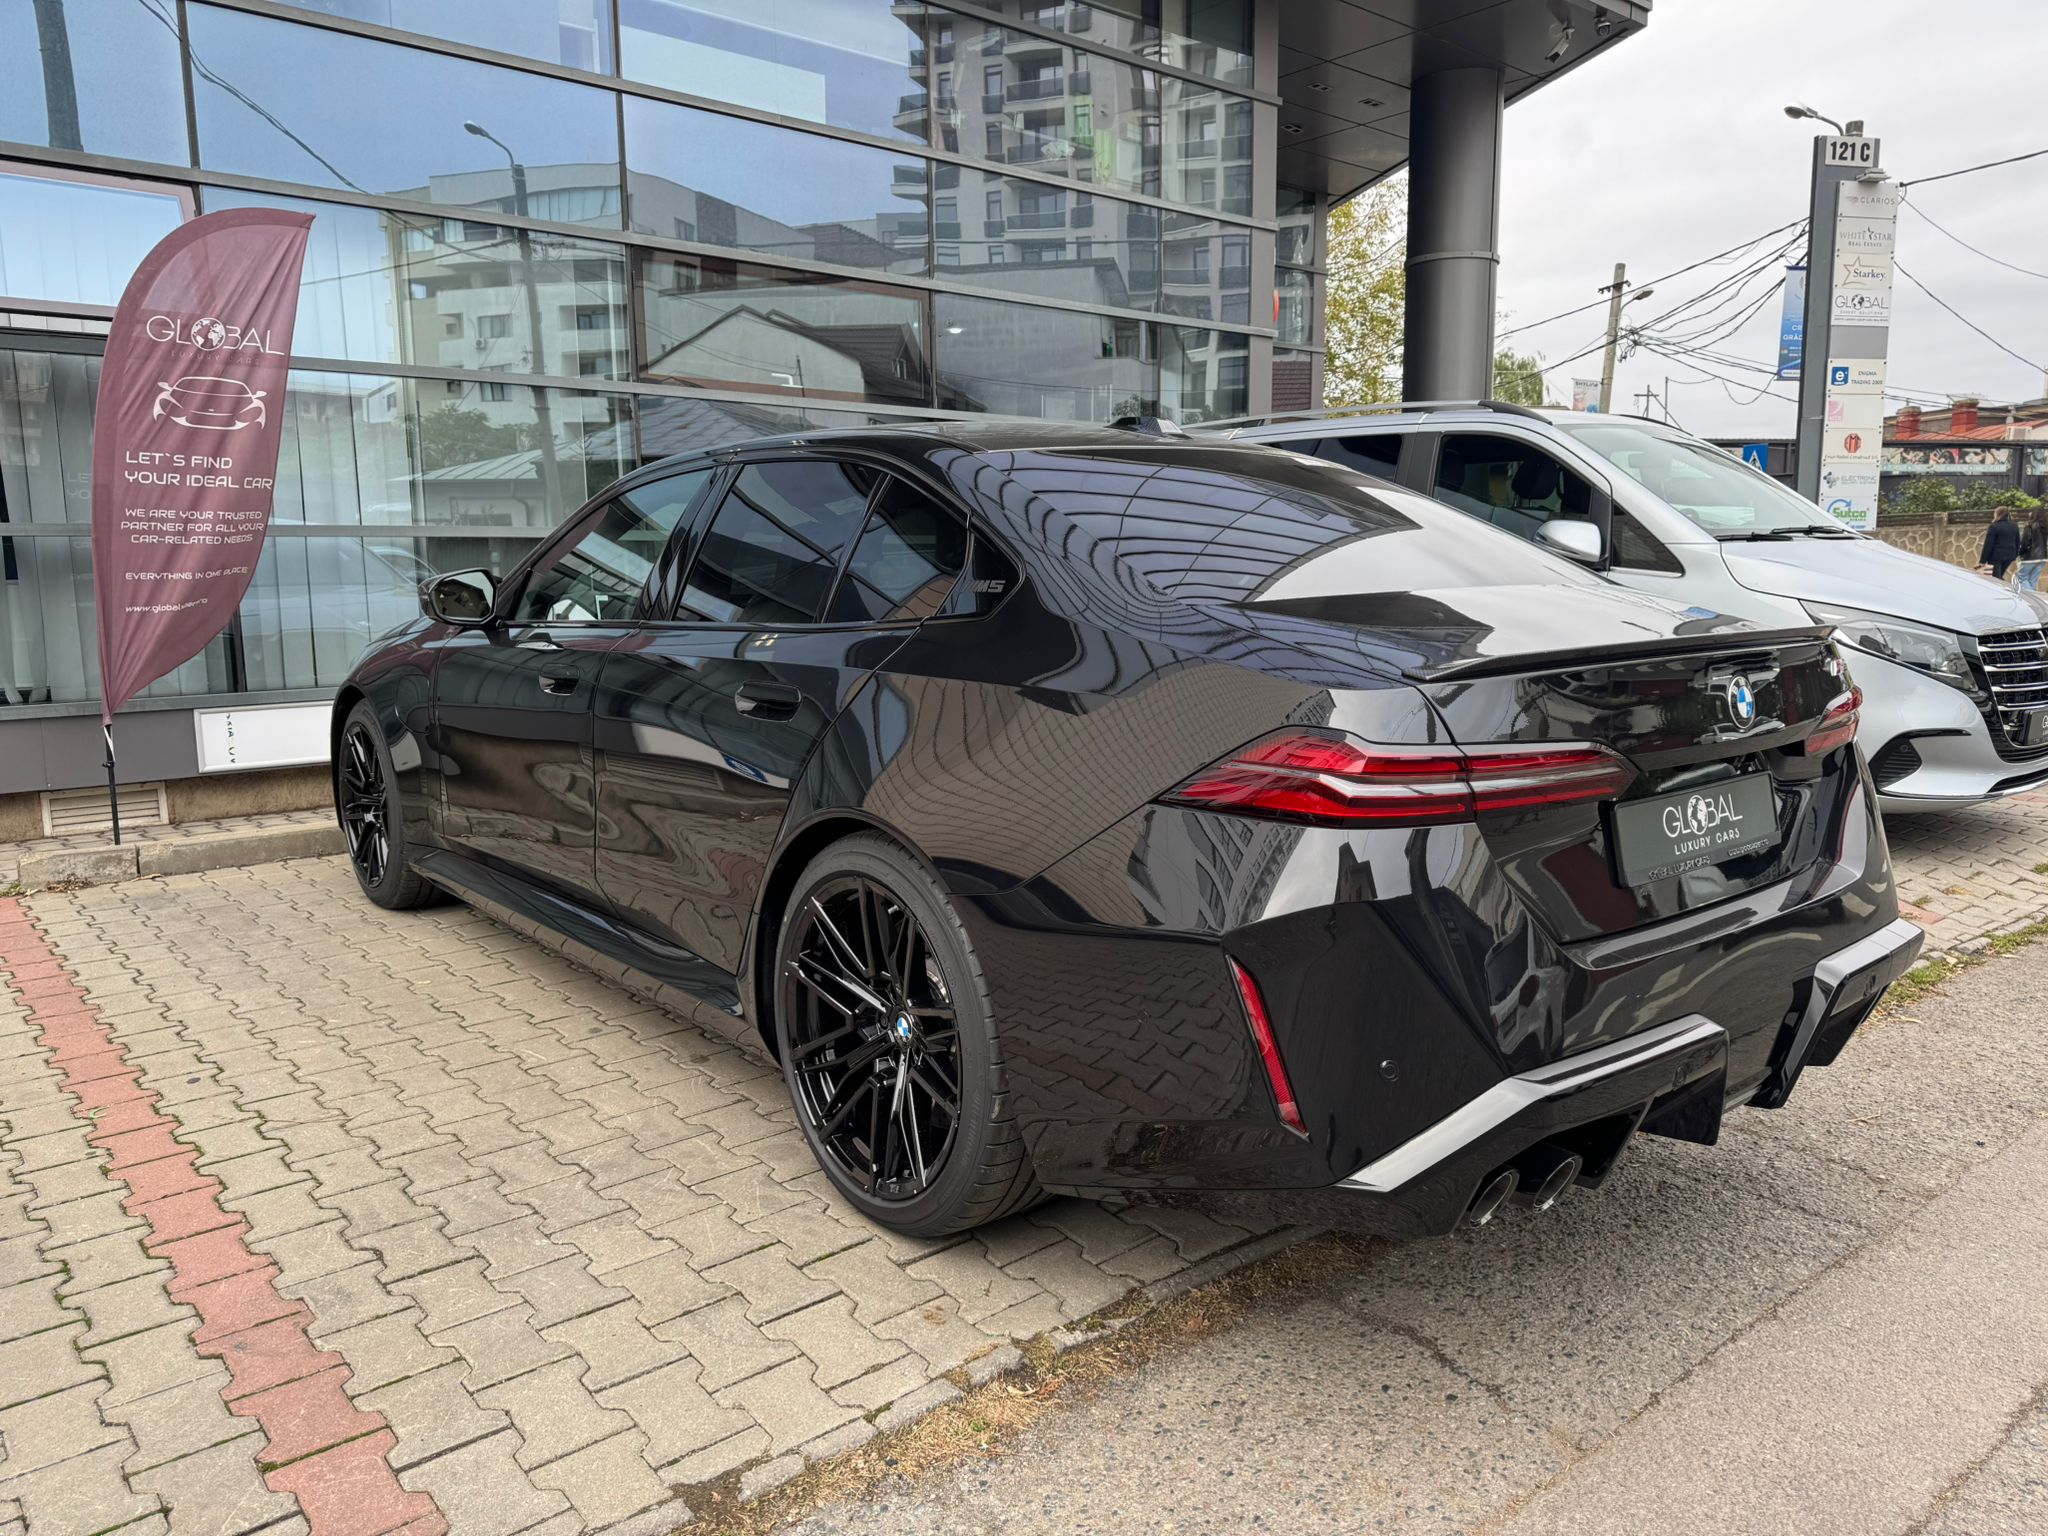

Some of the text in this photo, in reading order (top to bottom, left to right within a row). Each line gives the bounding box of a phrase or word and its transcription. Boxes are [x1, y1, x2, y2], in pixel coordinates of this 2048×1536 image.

[1830, 141, 1870, 162] 121 C
[1860, 195, 1895, 206] CLARIOS
[1840, 230, 1892, 241] WHITE STAR
[1853, 268, 1885, 282] Starkey
[1834, 294, 1889, 310] GLOBAL
[146, 315, 285, 356] GLOBAL
[191, 456, 232, 468] FIND
[124, 470, 273, 490] YOUR IDEAL CAR
[125, 508, 263, 520] WE ARE YOUR TRUSTED
[1833, 508, 1867, 519] Sutco
[120, 521, 264, 532] PARTNER FOR ALL YOUR
[131, 534, 254, 544] CAR-RELATED NEEDS
[125, 572, 192, 580] EVERYTHING
[205, 570, 222, 578] ONE
[1662, 793, 1744, 838] GLOBAL
[1674, 835, 1712, 856] LUXURY
[1715, 828, 1741, 844] CARS
